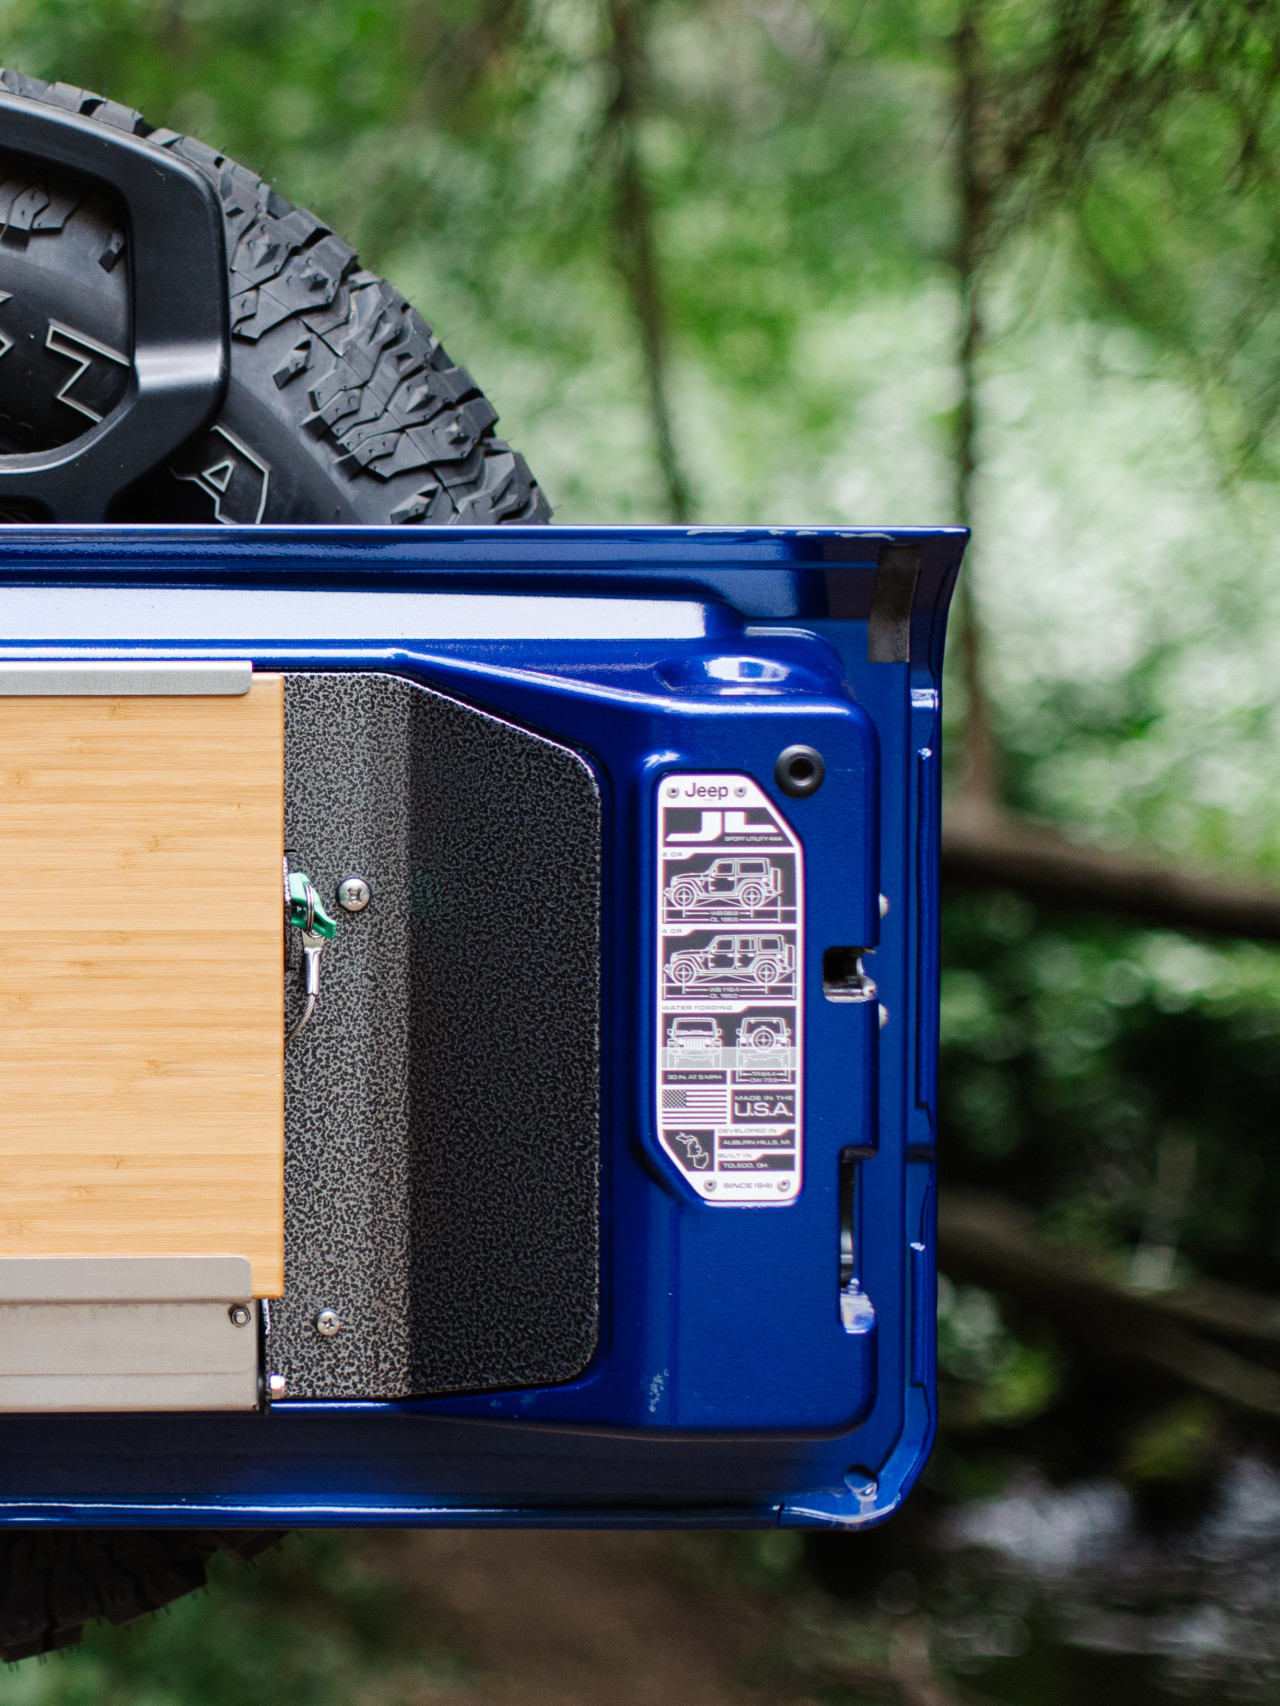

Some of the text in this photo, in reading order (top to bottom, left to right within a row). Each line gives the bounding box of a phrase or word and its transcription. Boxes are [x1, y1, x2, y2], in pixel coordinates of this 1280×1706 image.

[684, 782, 729, 801] Jeep
[665, 811, 779, 842] JL
[734, 1102, 793, 1116] U.S.A.
